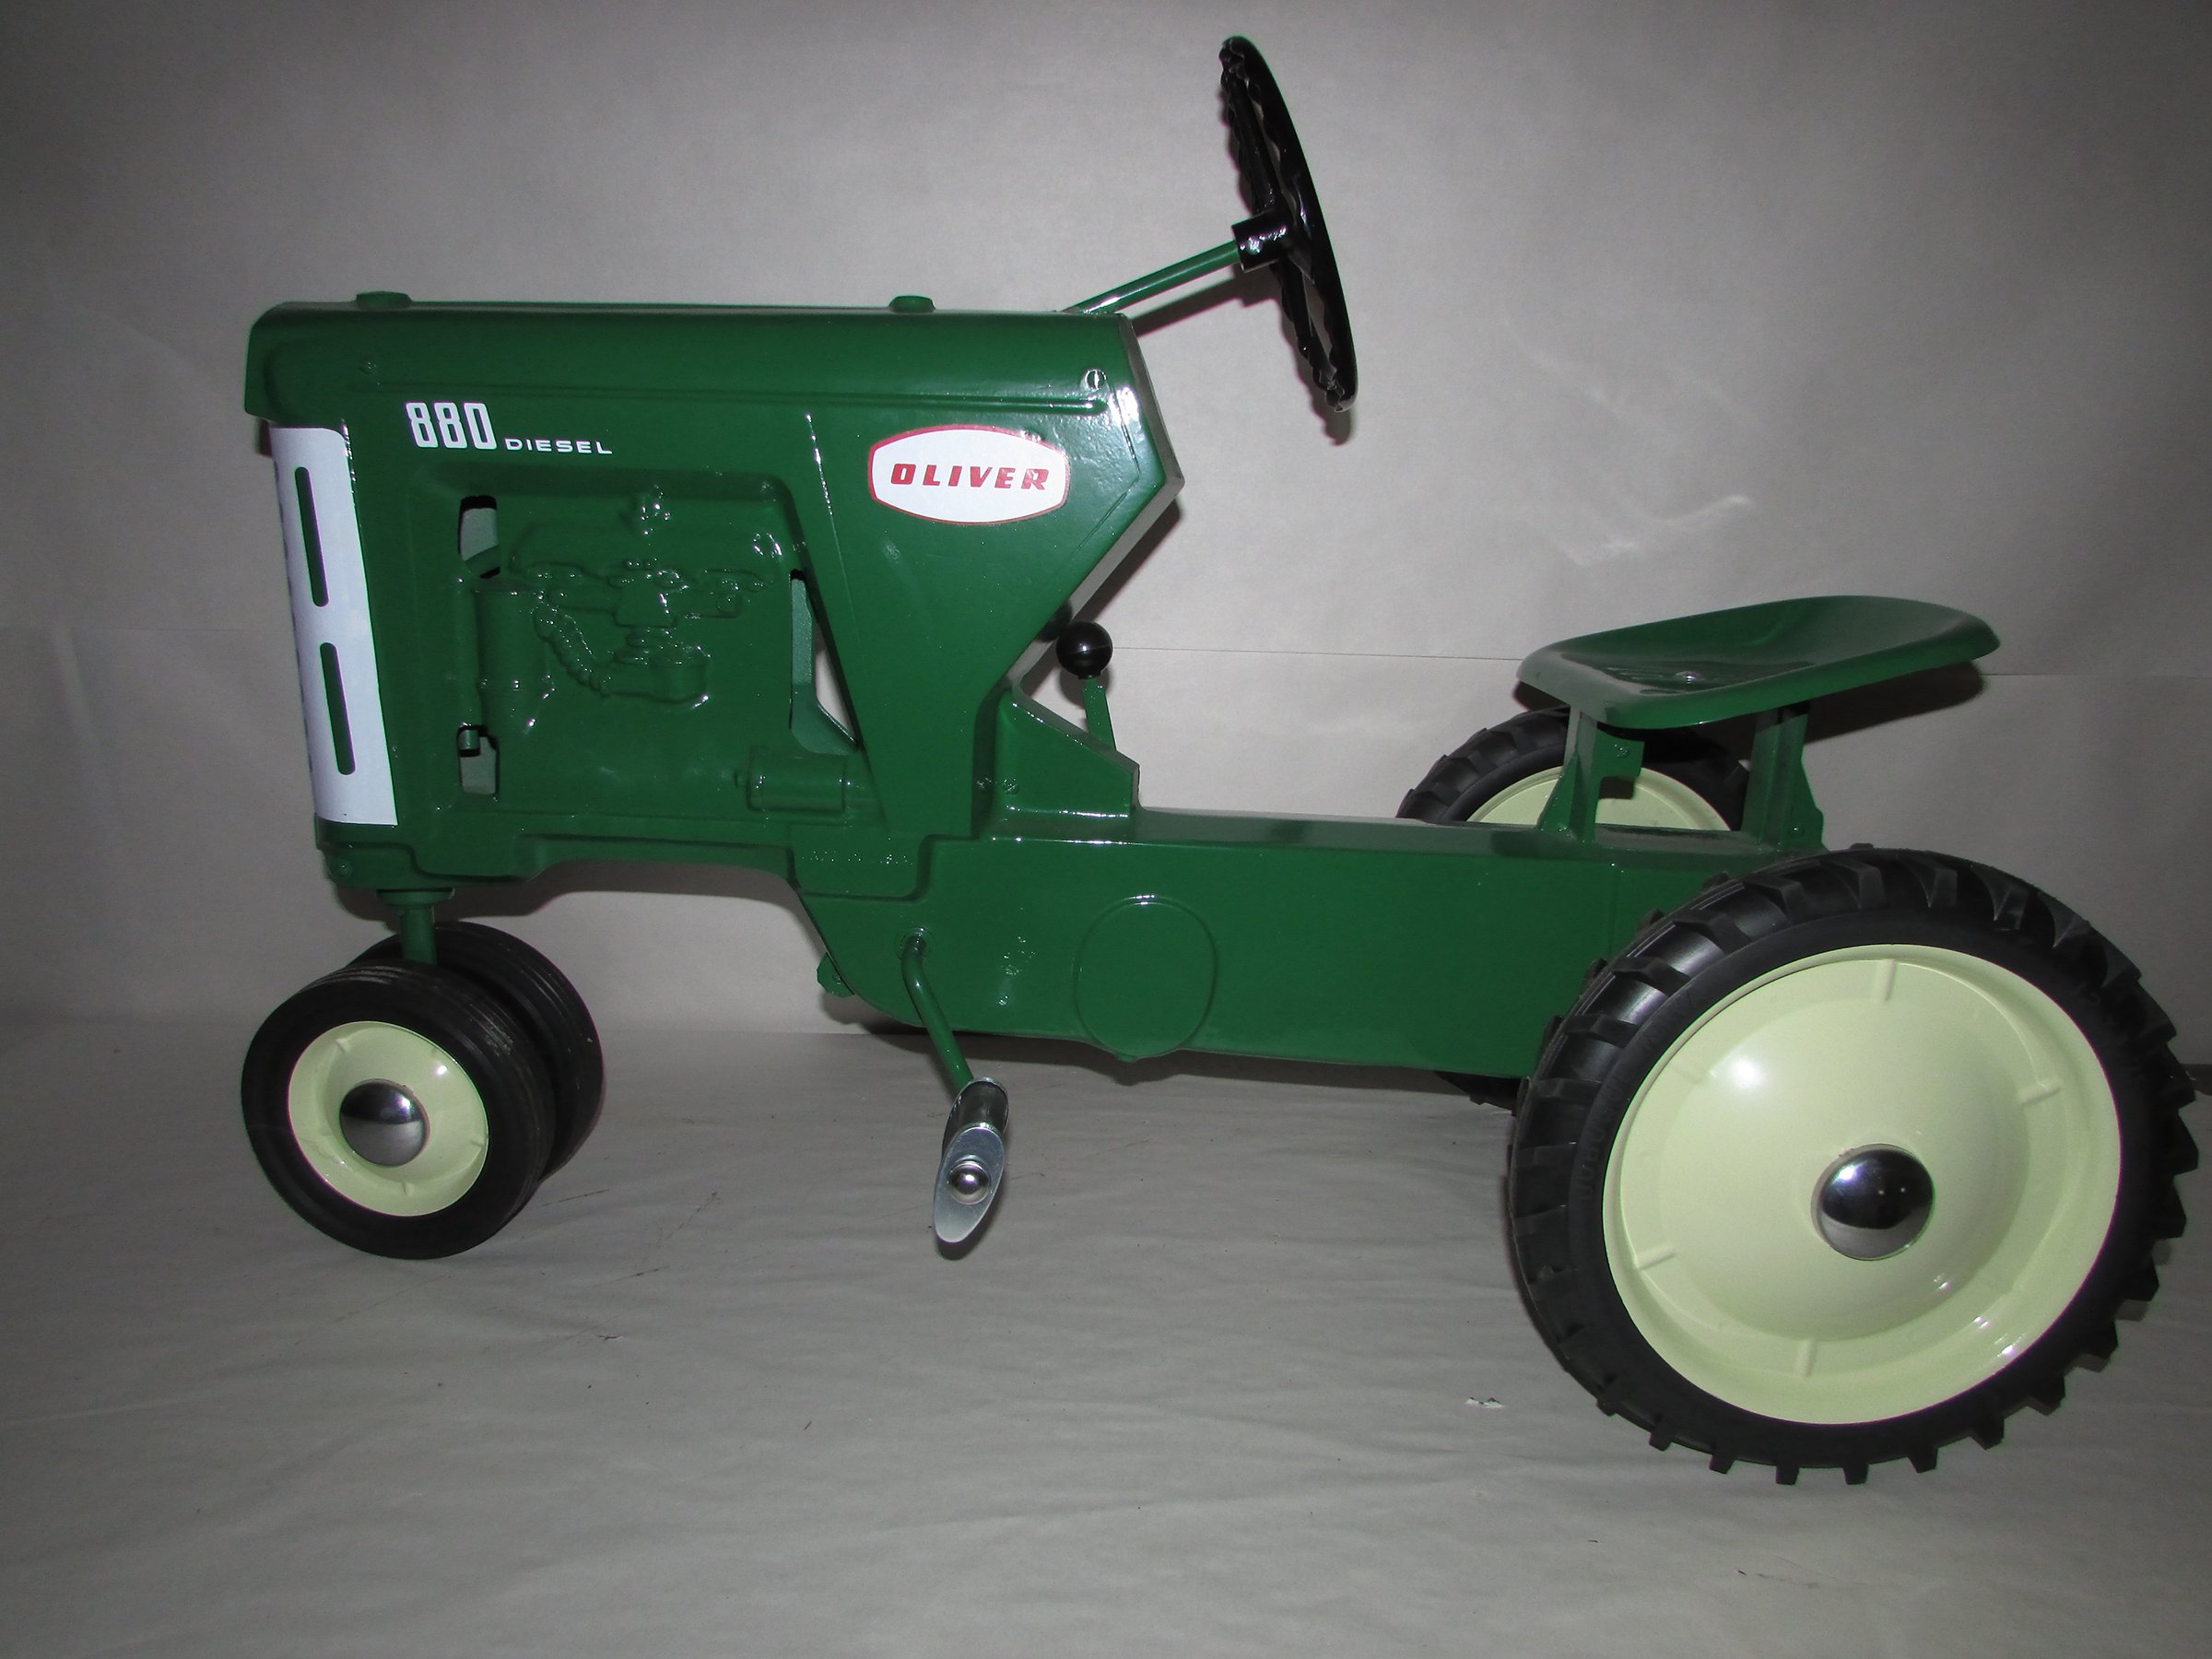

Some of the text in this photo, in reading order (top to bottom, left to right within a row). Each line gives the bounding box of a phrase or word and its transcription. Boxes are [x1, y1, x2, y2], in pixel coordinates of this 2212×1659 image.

[406, 402, 613, 454] 880 DIESEL
[890, 463, 1049, 490] OLIVER
